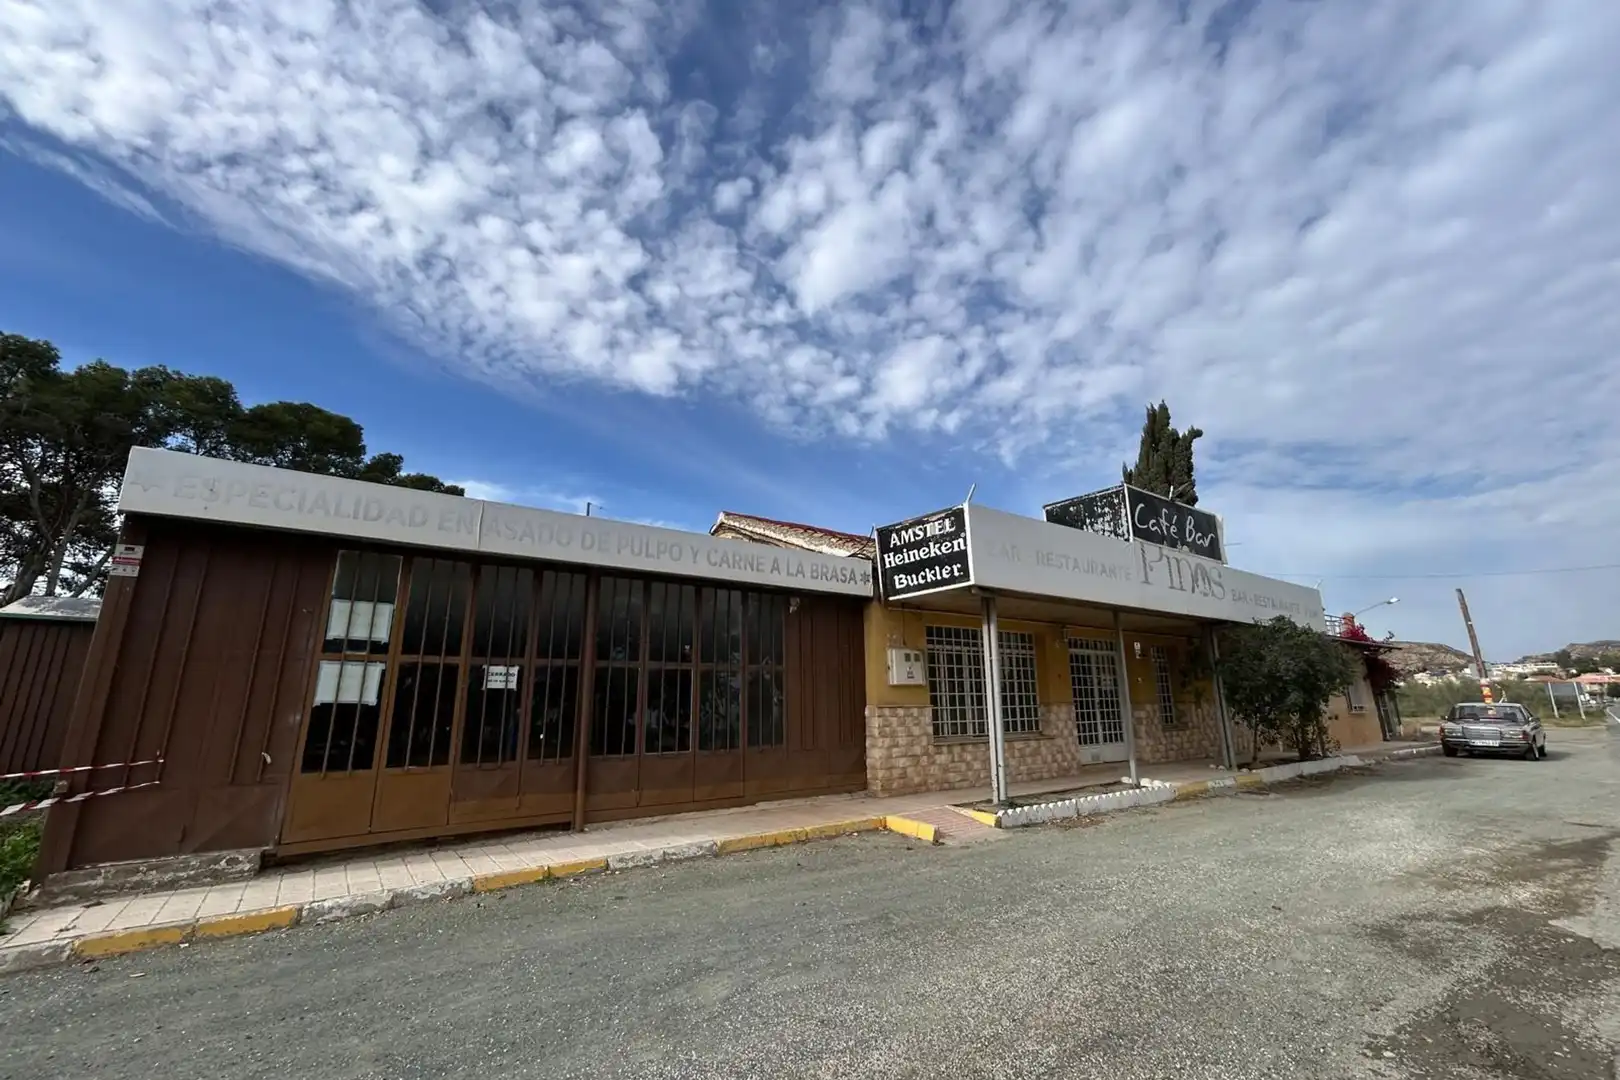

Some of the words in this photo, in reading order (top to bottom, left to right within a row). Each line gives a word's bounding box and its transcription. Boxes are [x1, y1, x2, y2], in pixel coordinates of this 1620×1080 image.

[172, 474, 429, 528] ESPECIALIDAD
[436, 507, 474, 535] EN
[484, 514, 573, 548] ASADO
[580, 530, 611, 552] DE
[617, 533, 683, 563] PULPO
[689, 544, 699, 565] Y
[706, 547, 766, 574] CARNE
[770, 559, 782, 577] A
[785, 560, 806, 581] LA
[810, 562, 858, 586] BRASA
[889, 518, 956, 548] AMSTEL
[1134, 503, 1179, 539] Café
[1186, 515, 1215, 548] Bar
[883, 537, 966, 569] Heineken
[1035, 549, 1133, 582] RESTAURANTE
